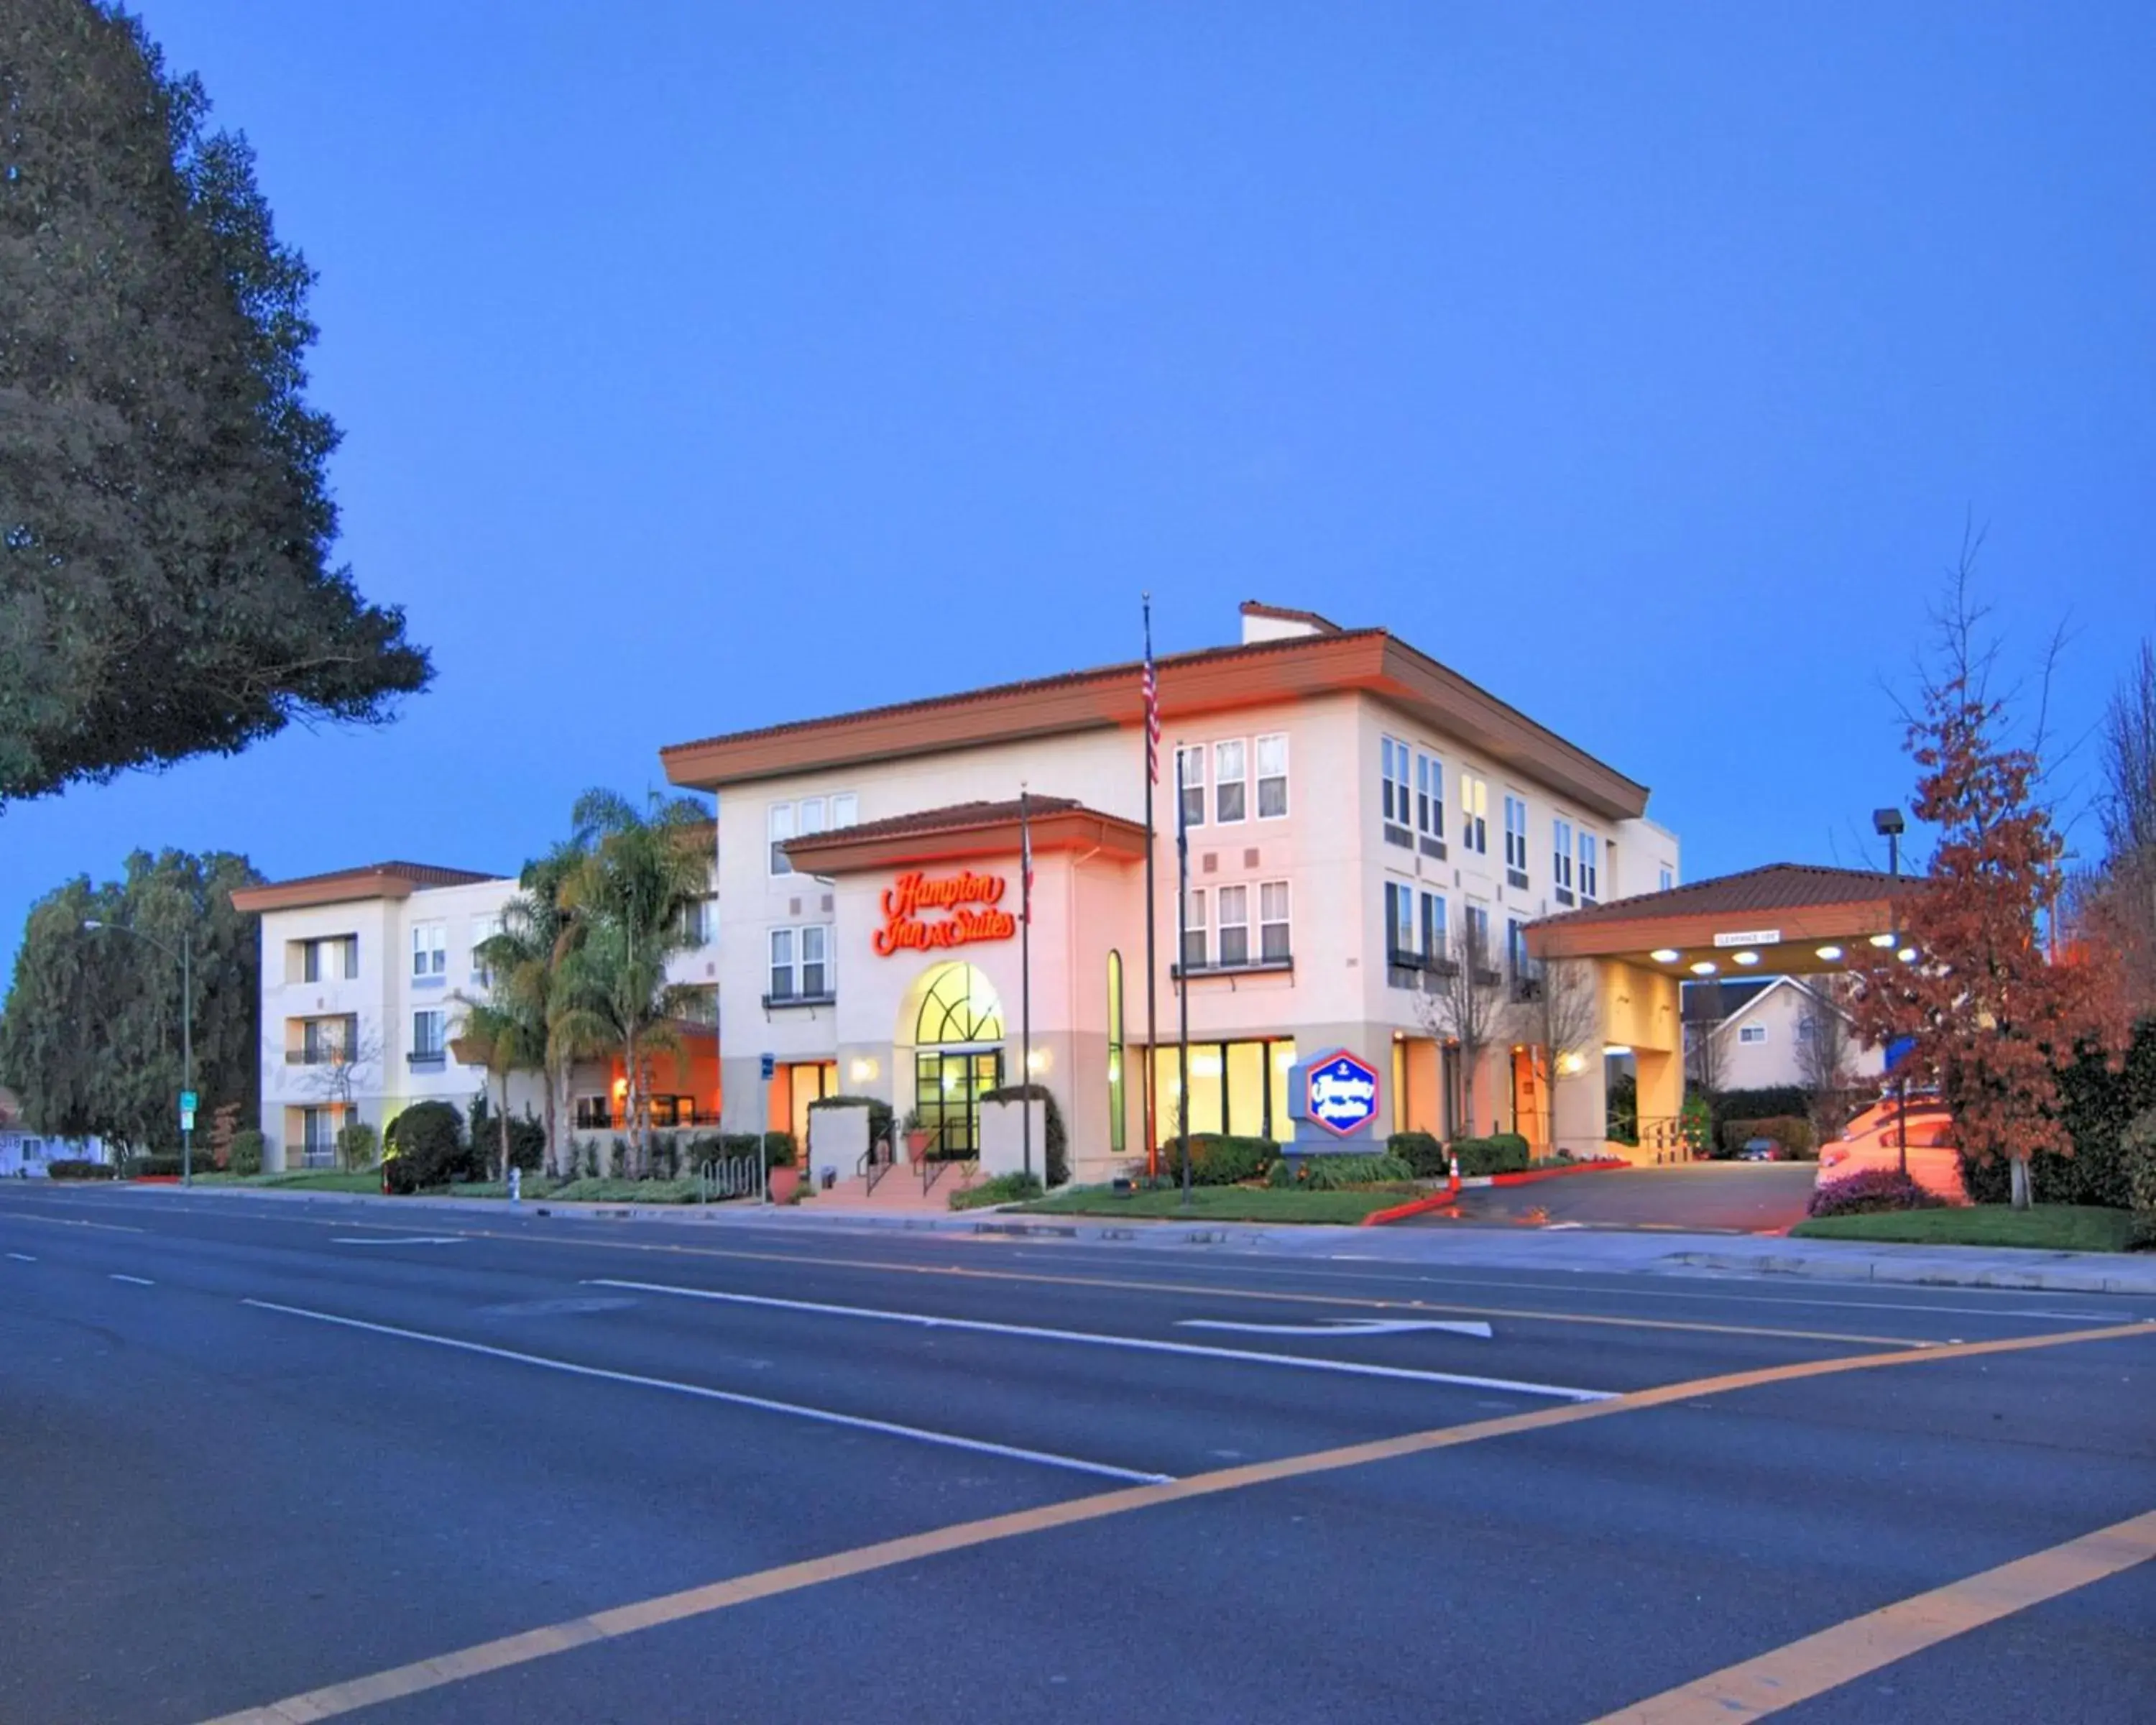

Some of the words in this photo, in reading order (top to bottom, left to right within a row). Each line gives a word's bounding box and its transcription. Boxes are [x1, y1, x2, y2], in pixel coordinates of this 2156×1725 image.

[881, 870, 1005, 919] Hampton
[873, 916, 933, 956] Inn
[948, 909, 1015, 944] Suites
